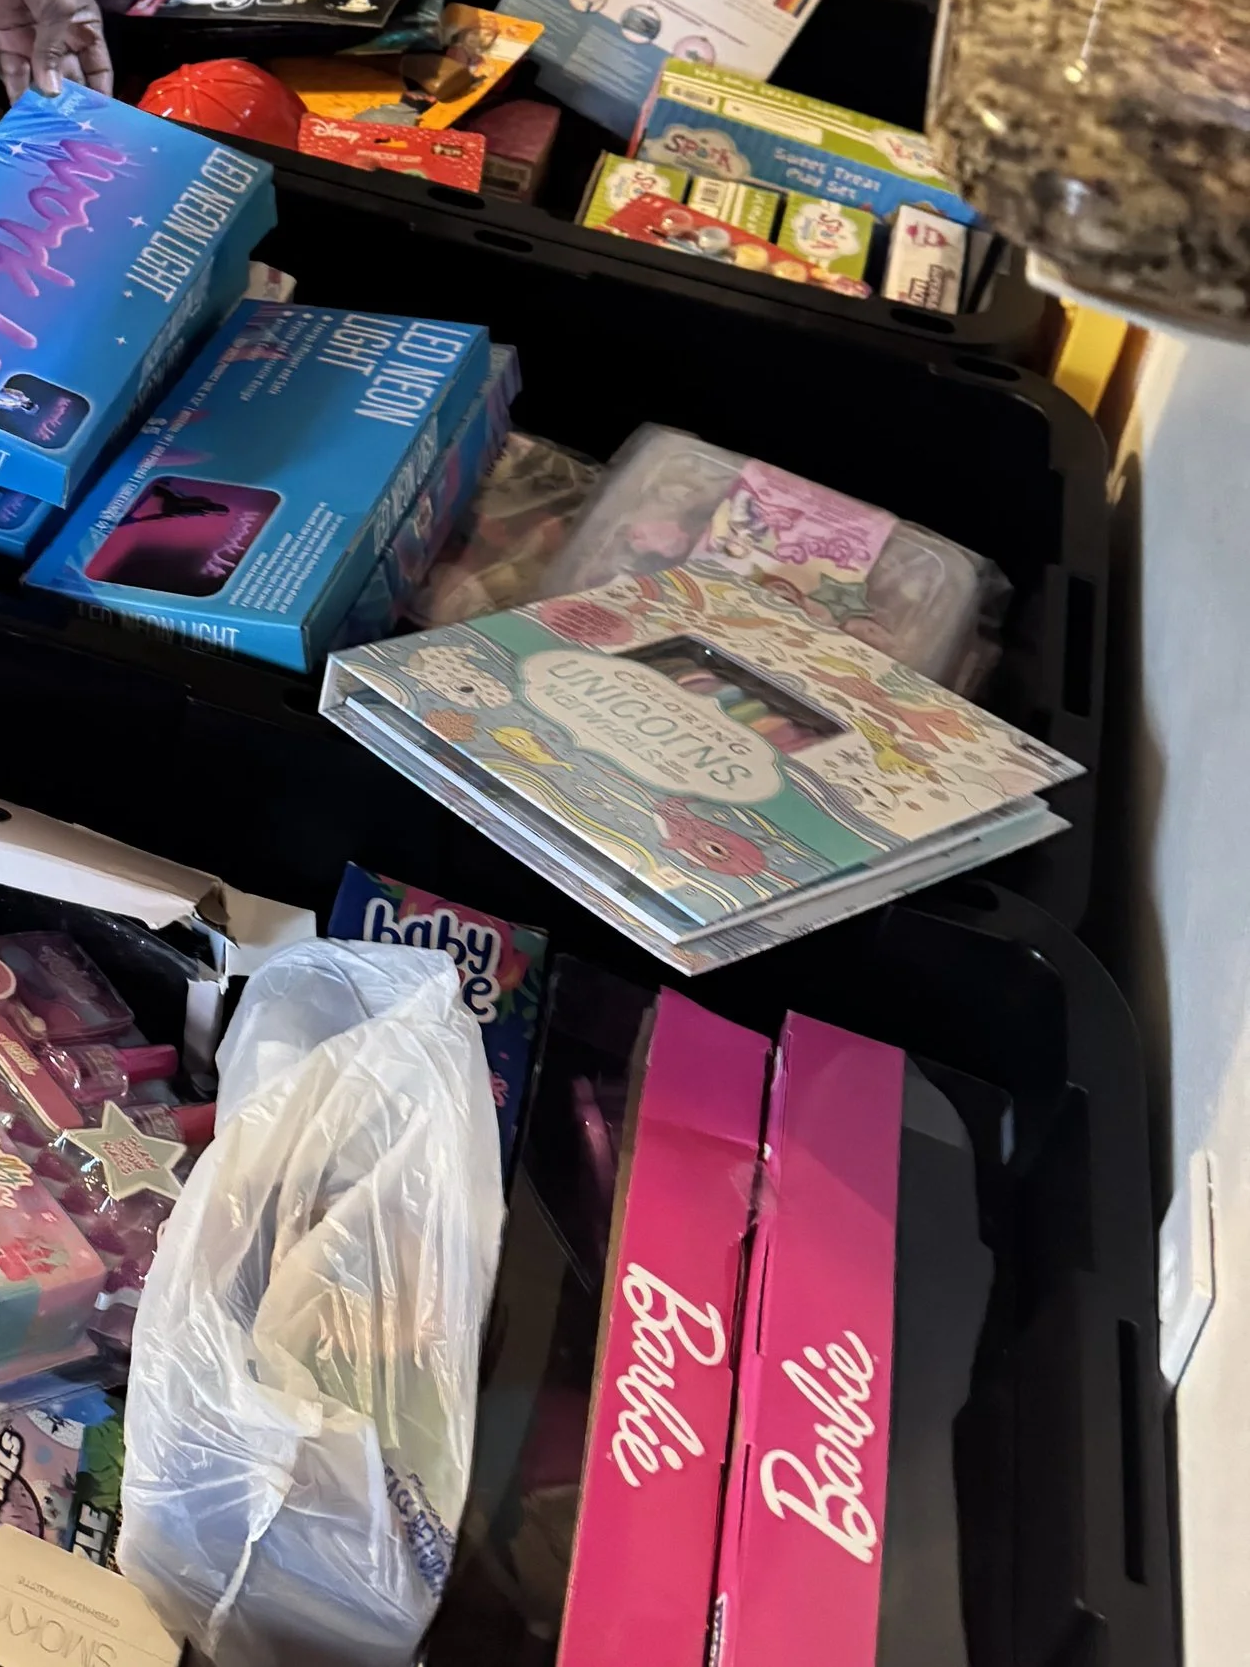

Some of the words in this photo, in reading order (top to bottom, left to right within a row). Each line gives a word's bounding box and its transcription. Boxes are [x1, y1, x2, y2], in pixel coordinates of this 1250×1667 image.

[309, 118, 361, 144] Disney
[200, 147, 258, 194] LED
[163, 180, 236, 246] NEON
[126, 231, 200, 303] LIGHT
[316, 313, 403, 378] LIGHT
[397, 321, 471, 364] LED
[354, 360, 446, 427] NEON
[611, 1261, 727, 1490] Barbie
[759, 1329, 877, 1564] Barbie
